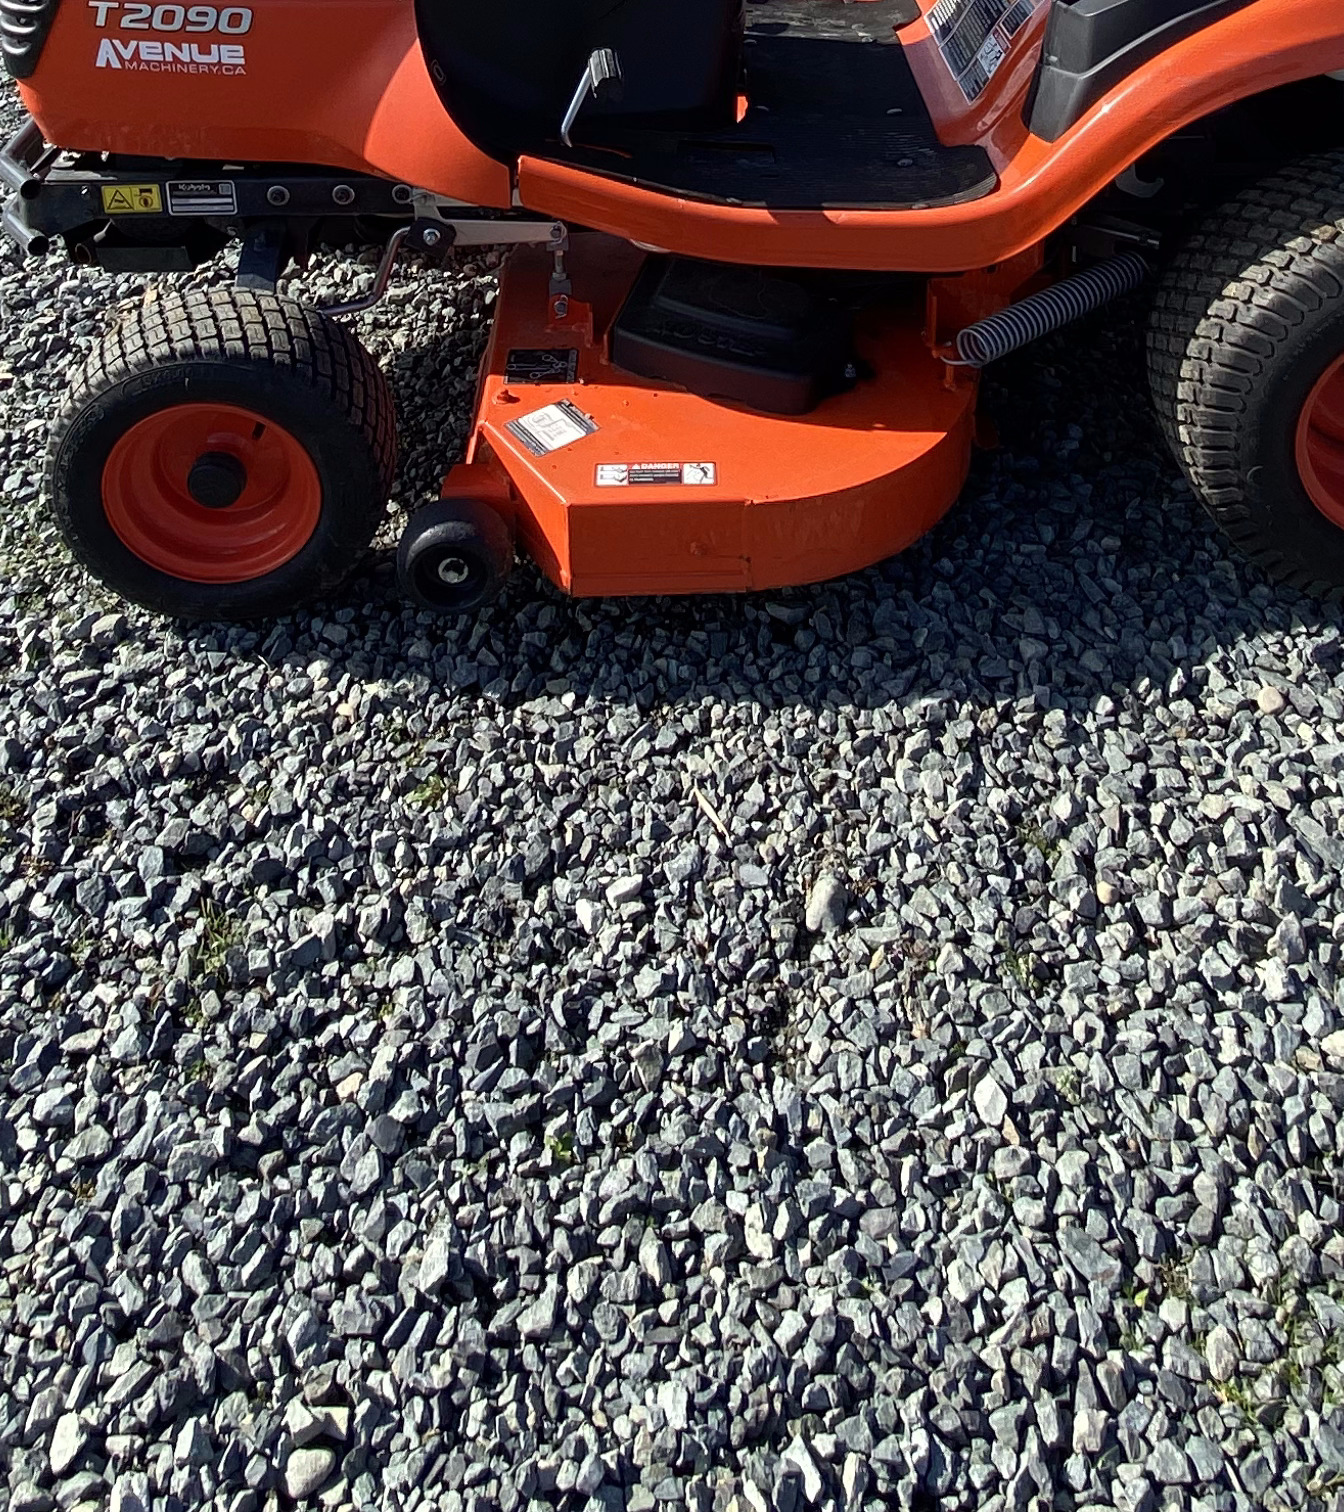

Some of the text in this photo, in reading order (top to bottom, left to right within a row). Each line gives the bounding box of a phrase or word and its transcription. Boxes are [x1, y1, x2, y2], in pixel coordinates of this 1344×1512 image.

[88, 0, 253, 35] T2090
[95, 38, 247, 70] AVENUE
[124, 60, 247, 76] MACHINERY.CA
[640, 462, 680, 470] DANGER
